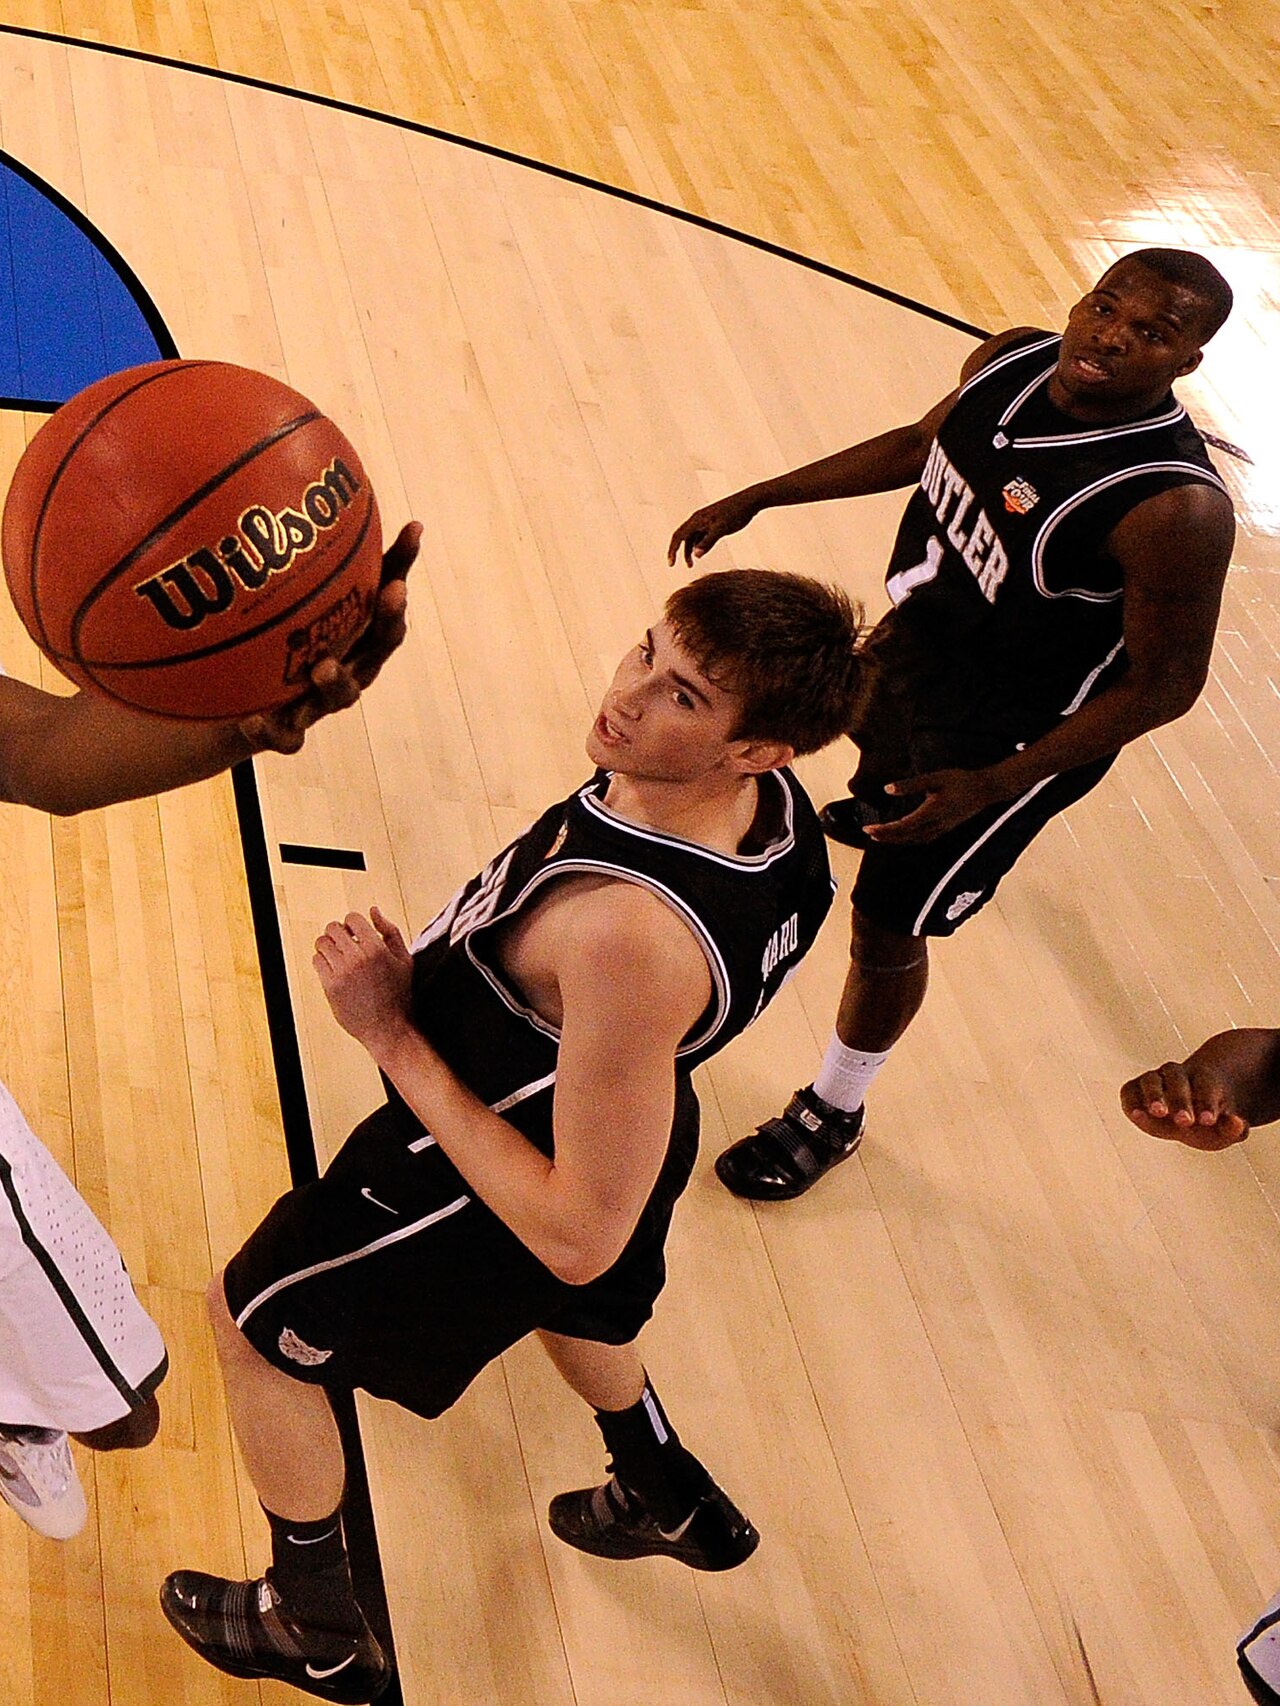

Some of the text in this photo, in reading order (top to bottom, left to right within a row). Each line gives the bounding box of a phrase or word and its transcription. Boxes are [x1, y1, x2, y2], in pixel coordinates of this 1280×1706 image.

[134, 457, 362, 631] Wilson
[920, 436, 1010, 605] BUTLER
[1003, 480, 1035, 512] FOUR
[885, 534, 945, 610] 1
